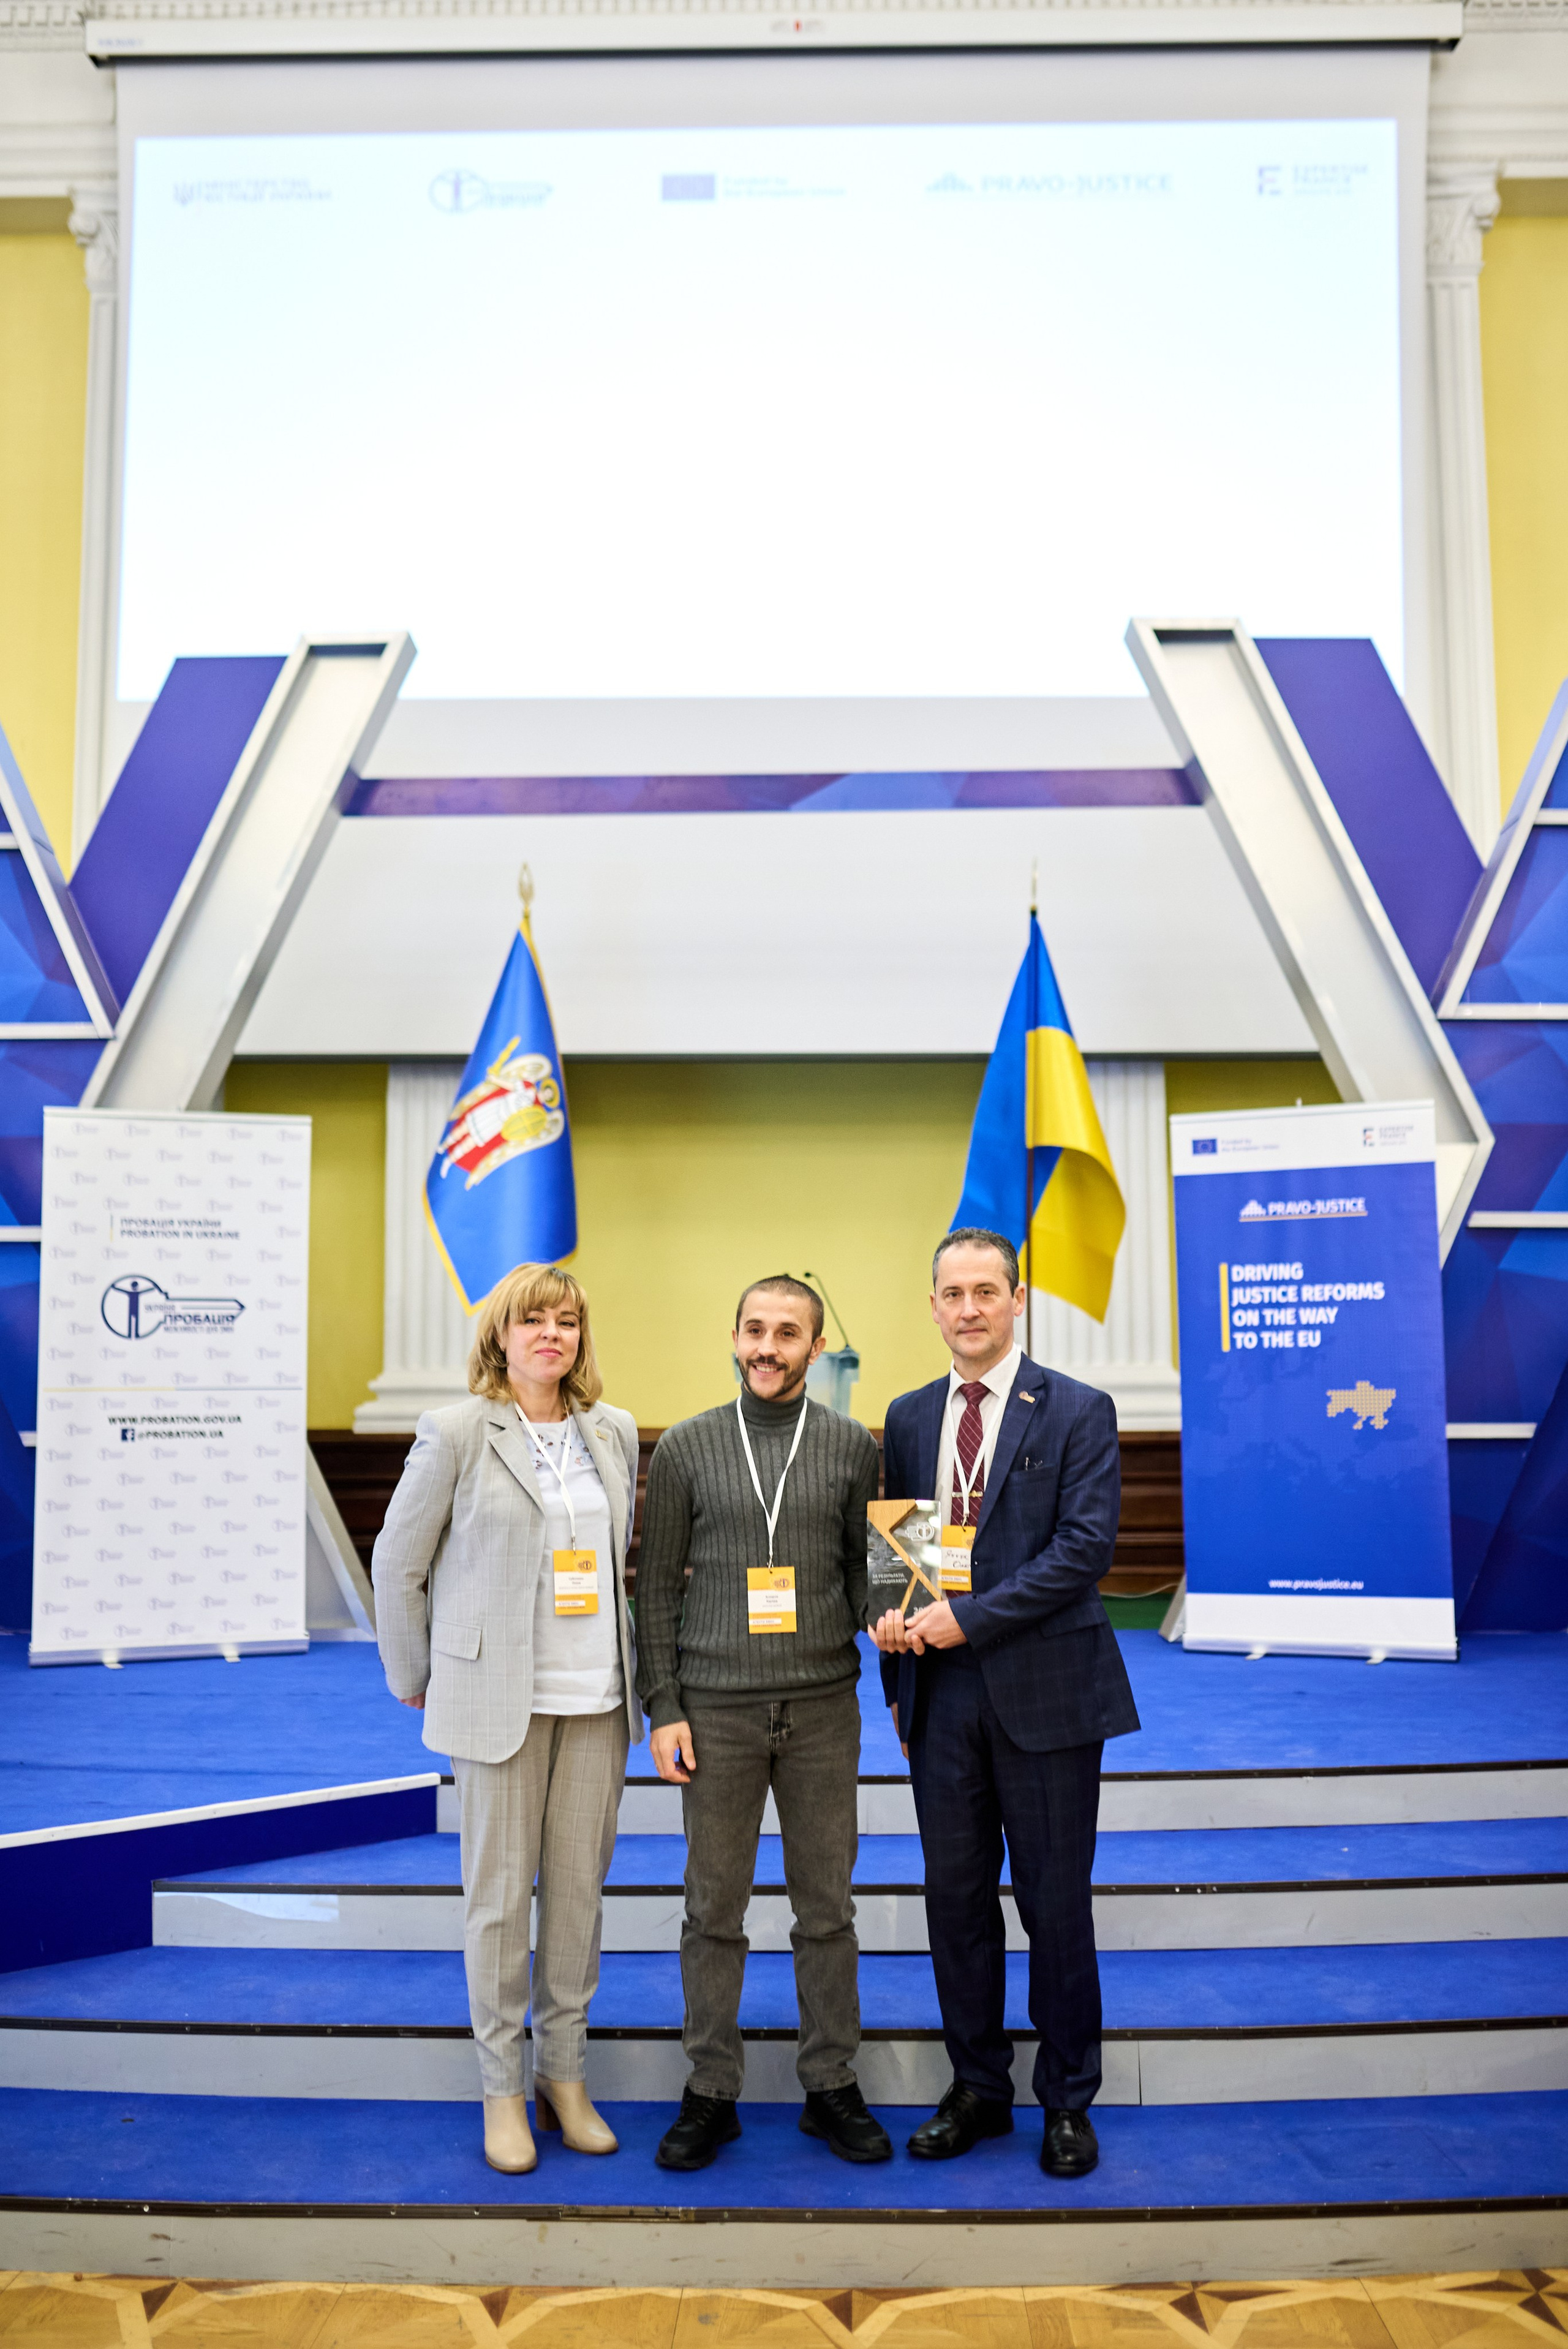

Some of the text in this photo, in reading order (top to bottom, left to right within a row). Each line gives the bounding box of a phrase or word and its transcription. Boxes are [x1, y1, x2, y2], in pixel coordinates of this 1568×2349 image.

[1268, 1197, 1365, 1215] PRAVO-JUSTICE
[121, 1218, 175, 1227] ПРОБАЦІЯ
[121, 1229, 240, 1240] PROBATION IN UKRAINE
[1231, 1262, 1303, 1282] DRIVING
[1231, 1281, 1385, 1307] JUSTICE REFORMS
[164, 1314, 235, 1325] ПРОБАЦІЯ
[1232, 1306, 1338, 1327] ON THE WAY
[1232, 1330, 1321, 1349] TO THE EU
[108, 1415, 242, 1425] WWW.PROBATION.GOV.UA
[138, 1429, 224, 1439] @PROBATION.UA
[1268, 1578, 1364, 1591] www.pravojustice.eu
